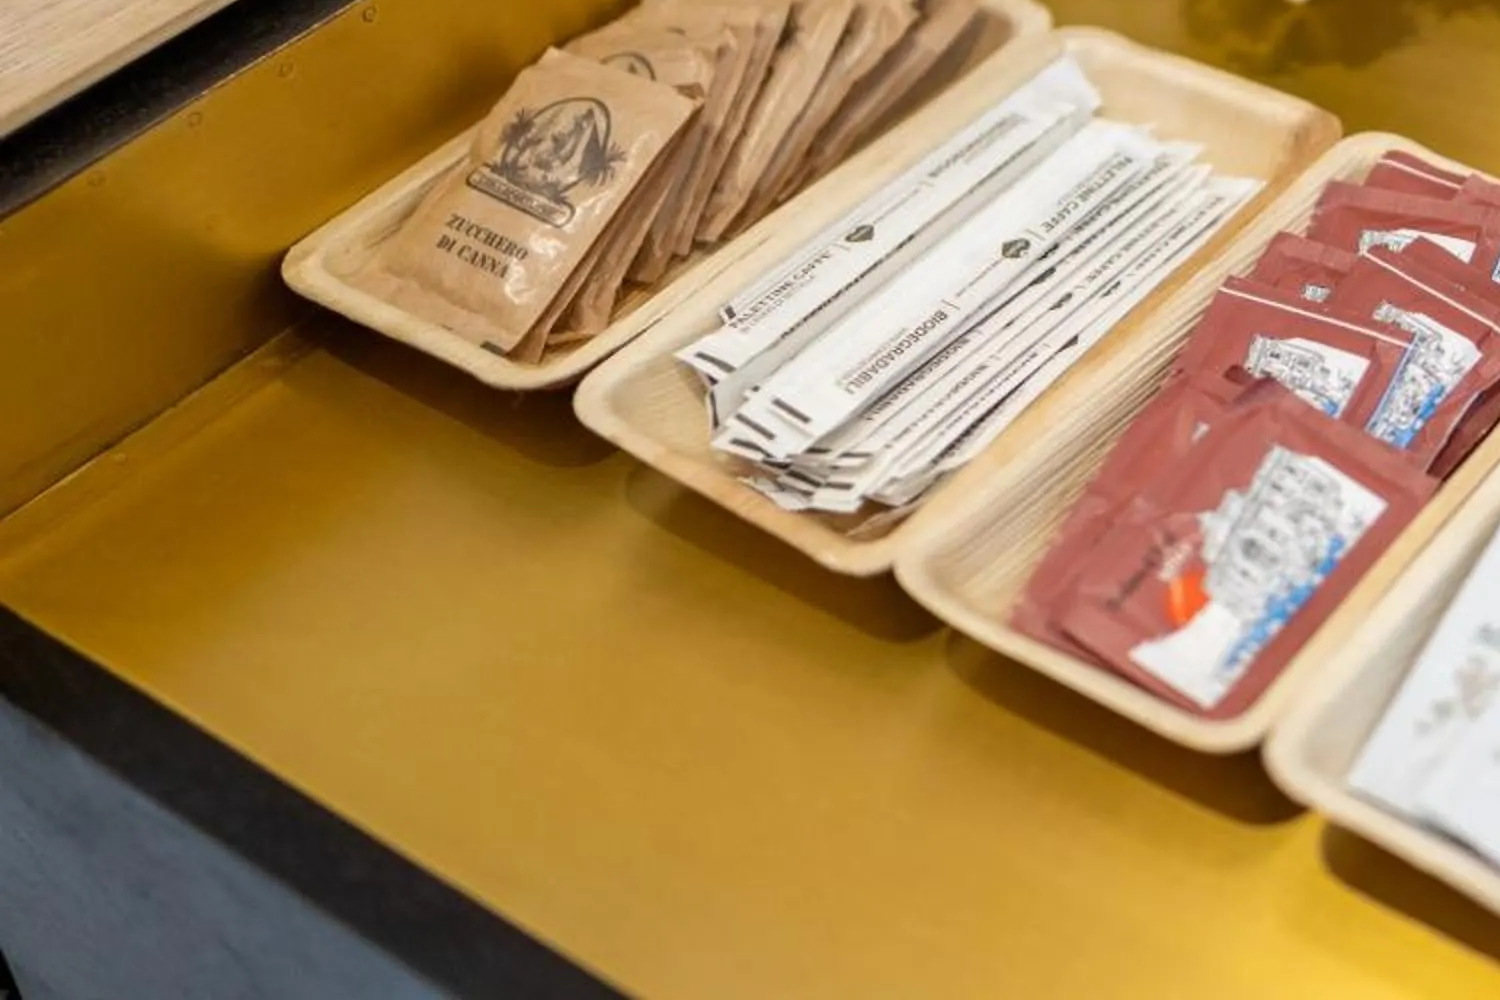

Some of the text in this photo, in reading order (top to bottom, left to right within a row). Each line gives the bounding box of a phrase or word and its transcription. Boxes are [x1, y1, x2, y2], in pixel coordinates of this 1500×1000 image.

[435, 233, 457, 253] DI
[445, 212, 530, 262] ZUCCHERO
[844, 308, 949, 395] BIODEGRADABILI
